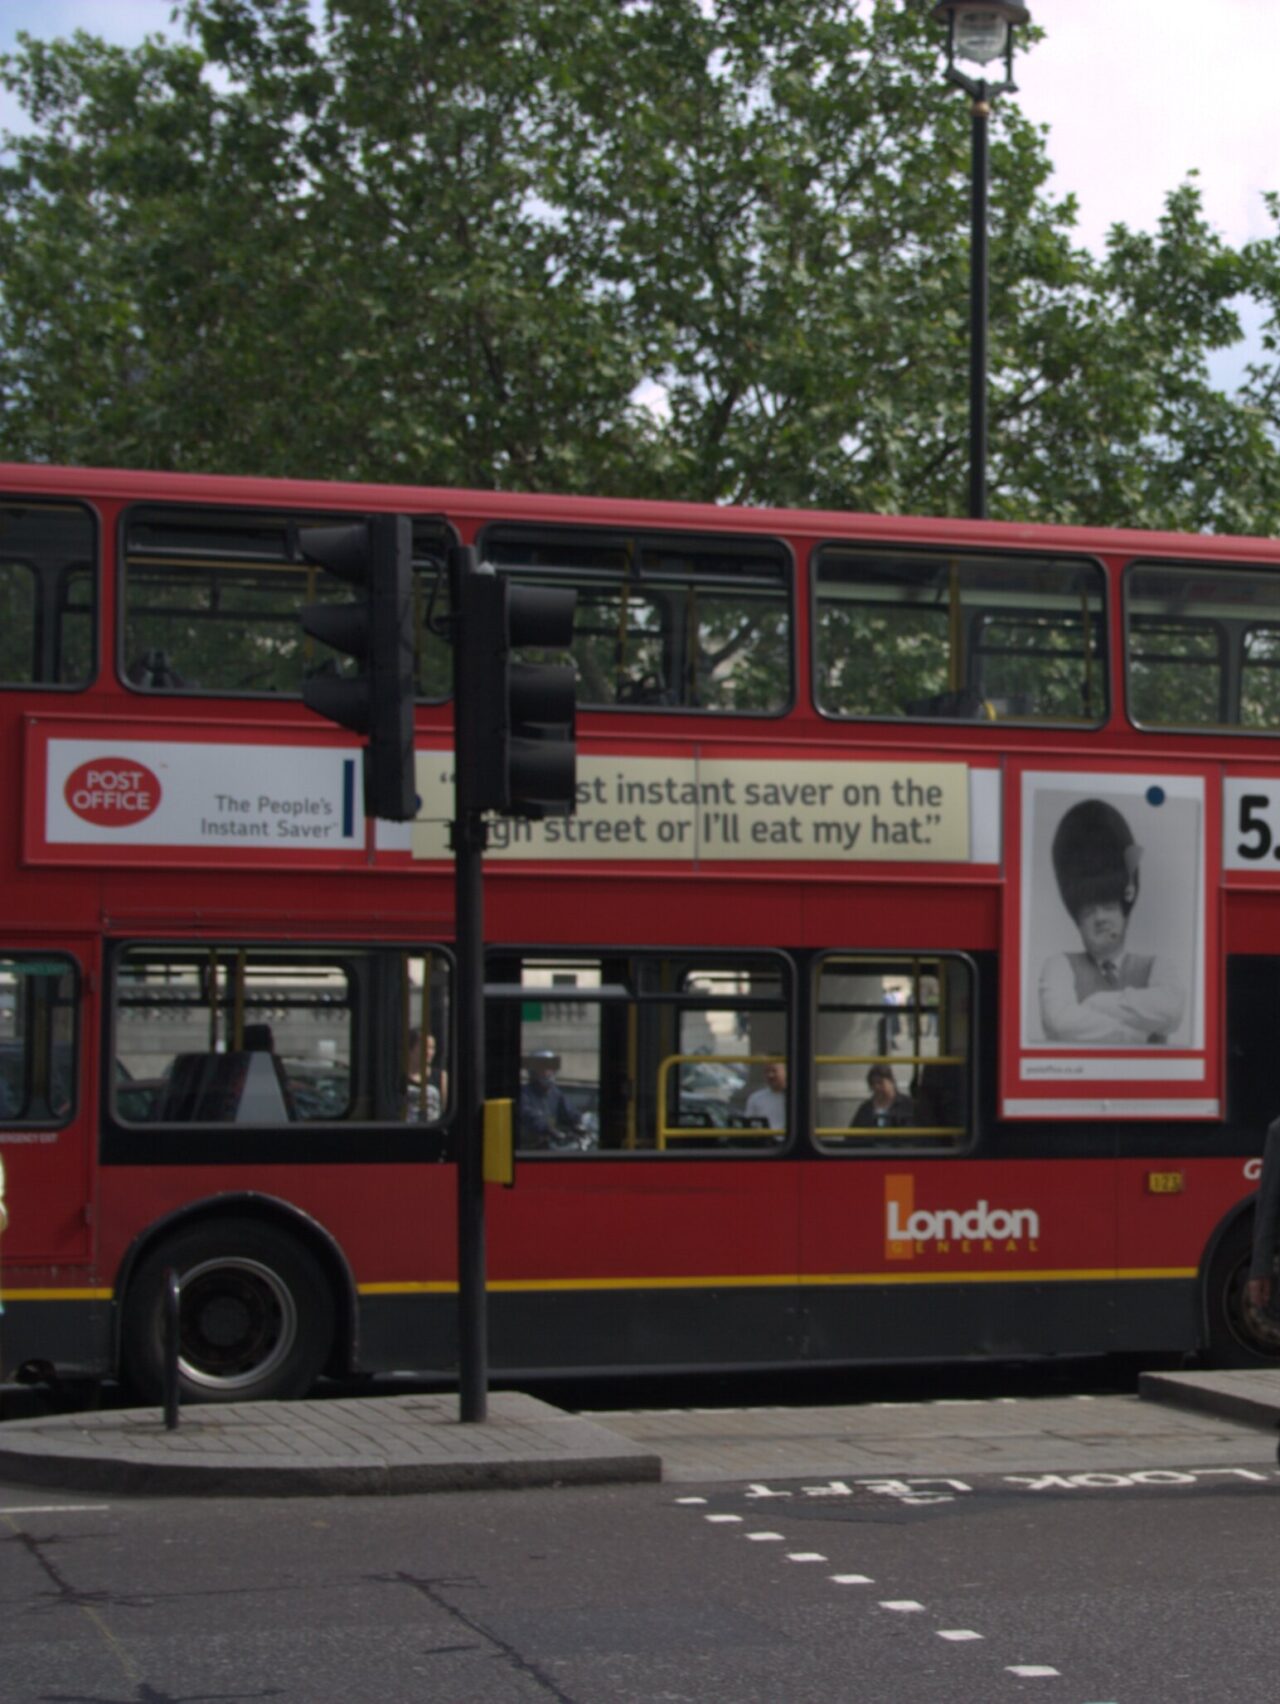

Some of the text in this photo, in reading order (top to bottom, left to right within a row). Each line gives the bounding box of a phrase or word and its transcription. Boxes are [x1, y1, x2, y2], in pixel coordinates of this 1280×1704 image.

[86, 769, 144, 790] POST
[616, 773, 735, 805] instant
[744, 782, 833, 806] saver
[843, 783, 881, 806] on
[891, 778, 943, 807] the
[72, 788, 151, 811] OFFICE
[214, 793, 333, 817] The People's
[201, 817, 269, 837] Instant
[544, 815, 647, 843] street
[656, 819, 691, 844] or
[703, 813, 740, 844] I'll
[750, 816, 803, 845] eat
[812, 819, 861, 851] my
[887, 1198, 1040, 1241] London
[890, 1240, 1040, 1255] GENERAL
